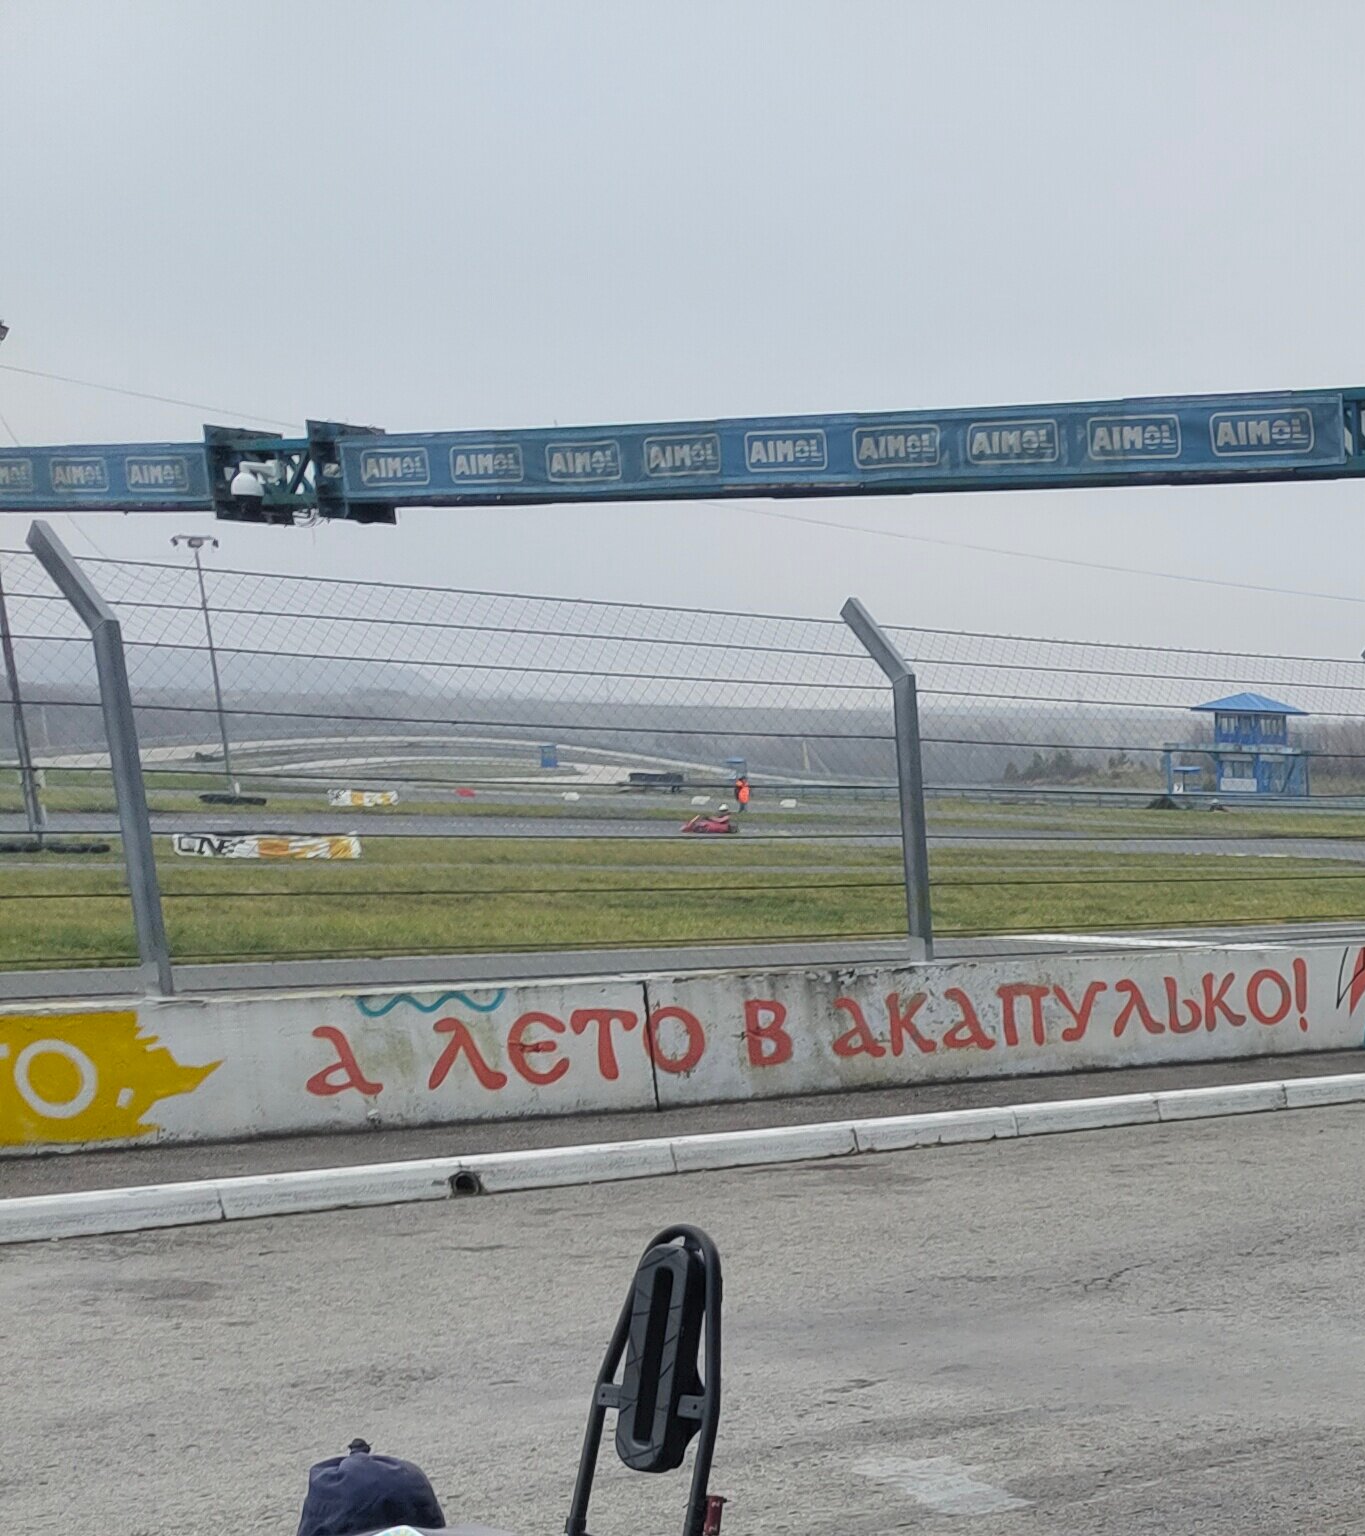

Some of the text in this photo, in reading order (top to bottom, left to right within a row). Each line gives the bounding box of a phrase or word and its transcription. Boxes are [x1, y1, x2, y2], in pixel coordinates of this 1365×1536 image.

[859, 433, 937, 461] AIMOL
[972, 428, 1055, 456] AIMOL
[1093, 424, 1176, 450] AIMOL
[1217, 419, 1308, 447] AIMOL
[551, 449, 618, 477] AIMOL
[649, 442, 719, 470] AIMOL
[750, 439, 824, 464] AIMOL
[130, 464, 182, 485] AIMOL
[365, 456, 427, 480] AIMOL
[455, 453, 521, 479] AIMOL
[428, 1005, 706, 1091] ЛЕТО
[744, 999, 793, 1067] В
[0, 1038, 134, 1118] О,
